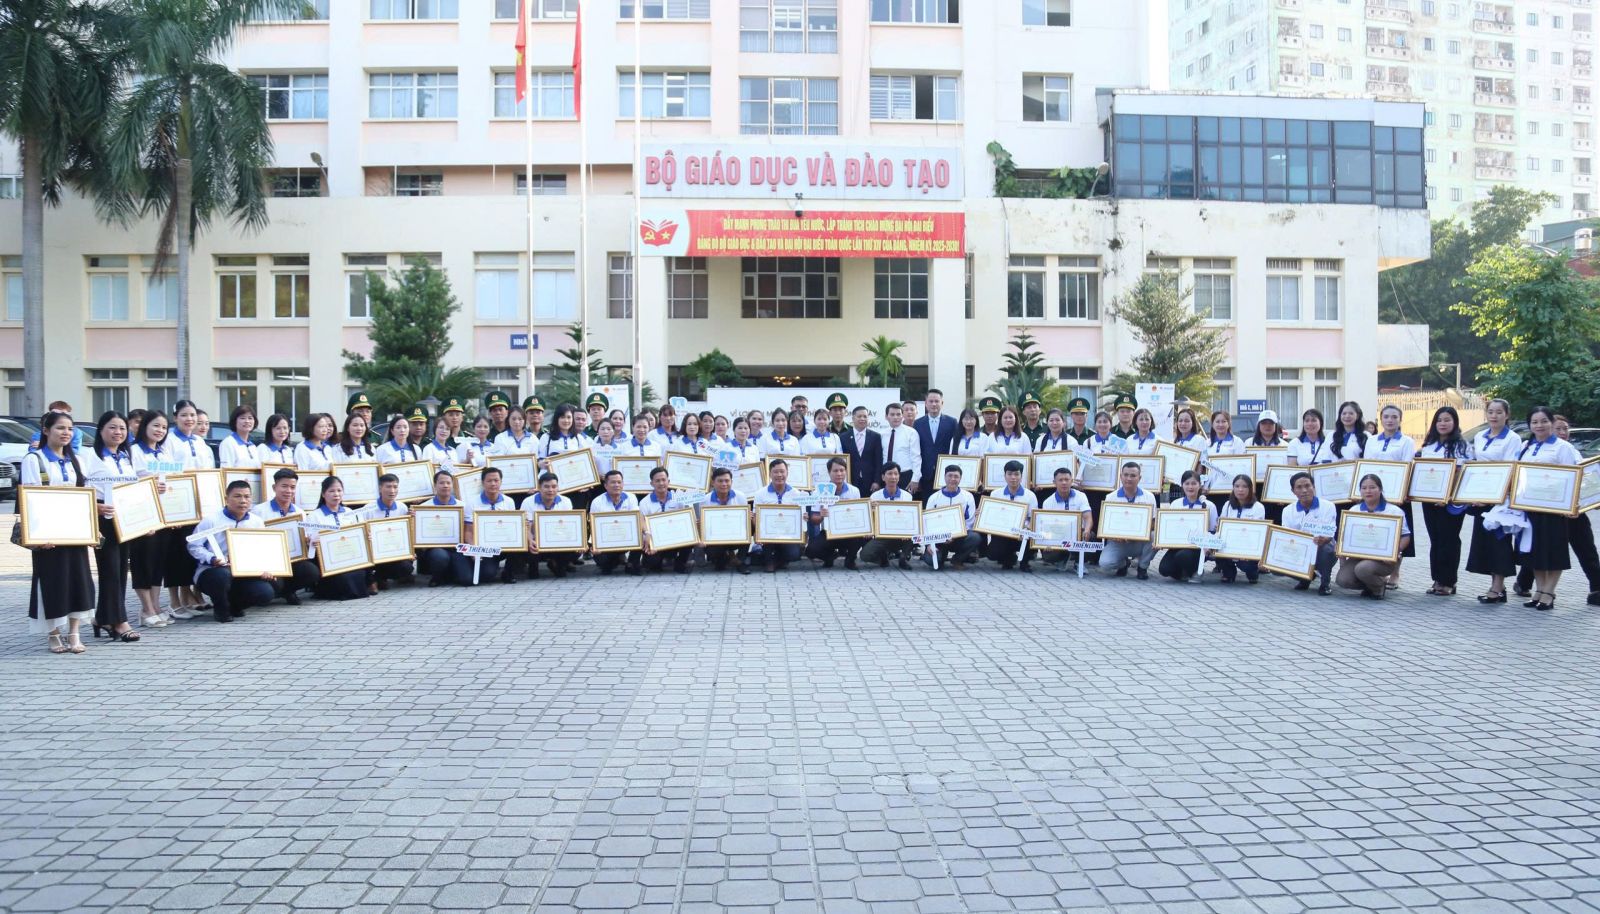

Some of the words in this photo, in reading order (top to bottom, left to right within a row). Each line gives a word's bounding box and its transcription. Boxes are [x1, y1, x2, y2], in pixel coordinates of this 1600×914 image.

[645, 149, 677, 192] BỘ
[685, 150, 742, 186] GIÁO
[750, 156, 798, 192] DỤC
[806, 151, 837, 187] VÀ
[844, 152, 894, 188] ĐÀO
[903, 159, 950, 194] TẠO
[513, 337, 528, 345] NHÀ
